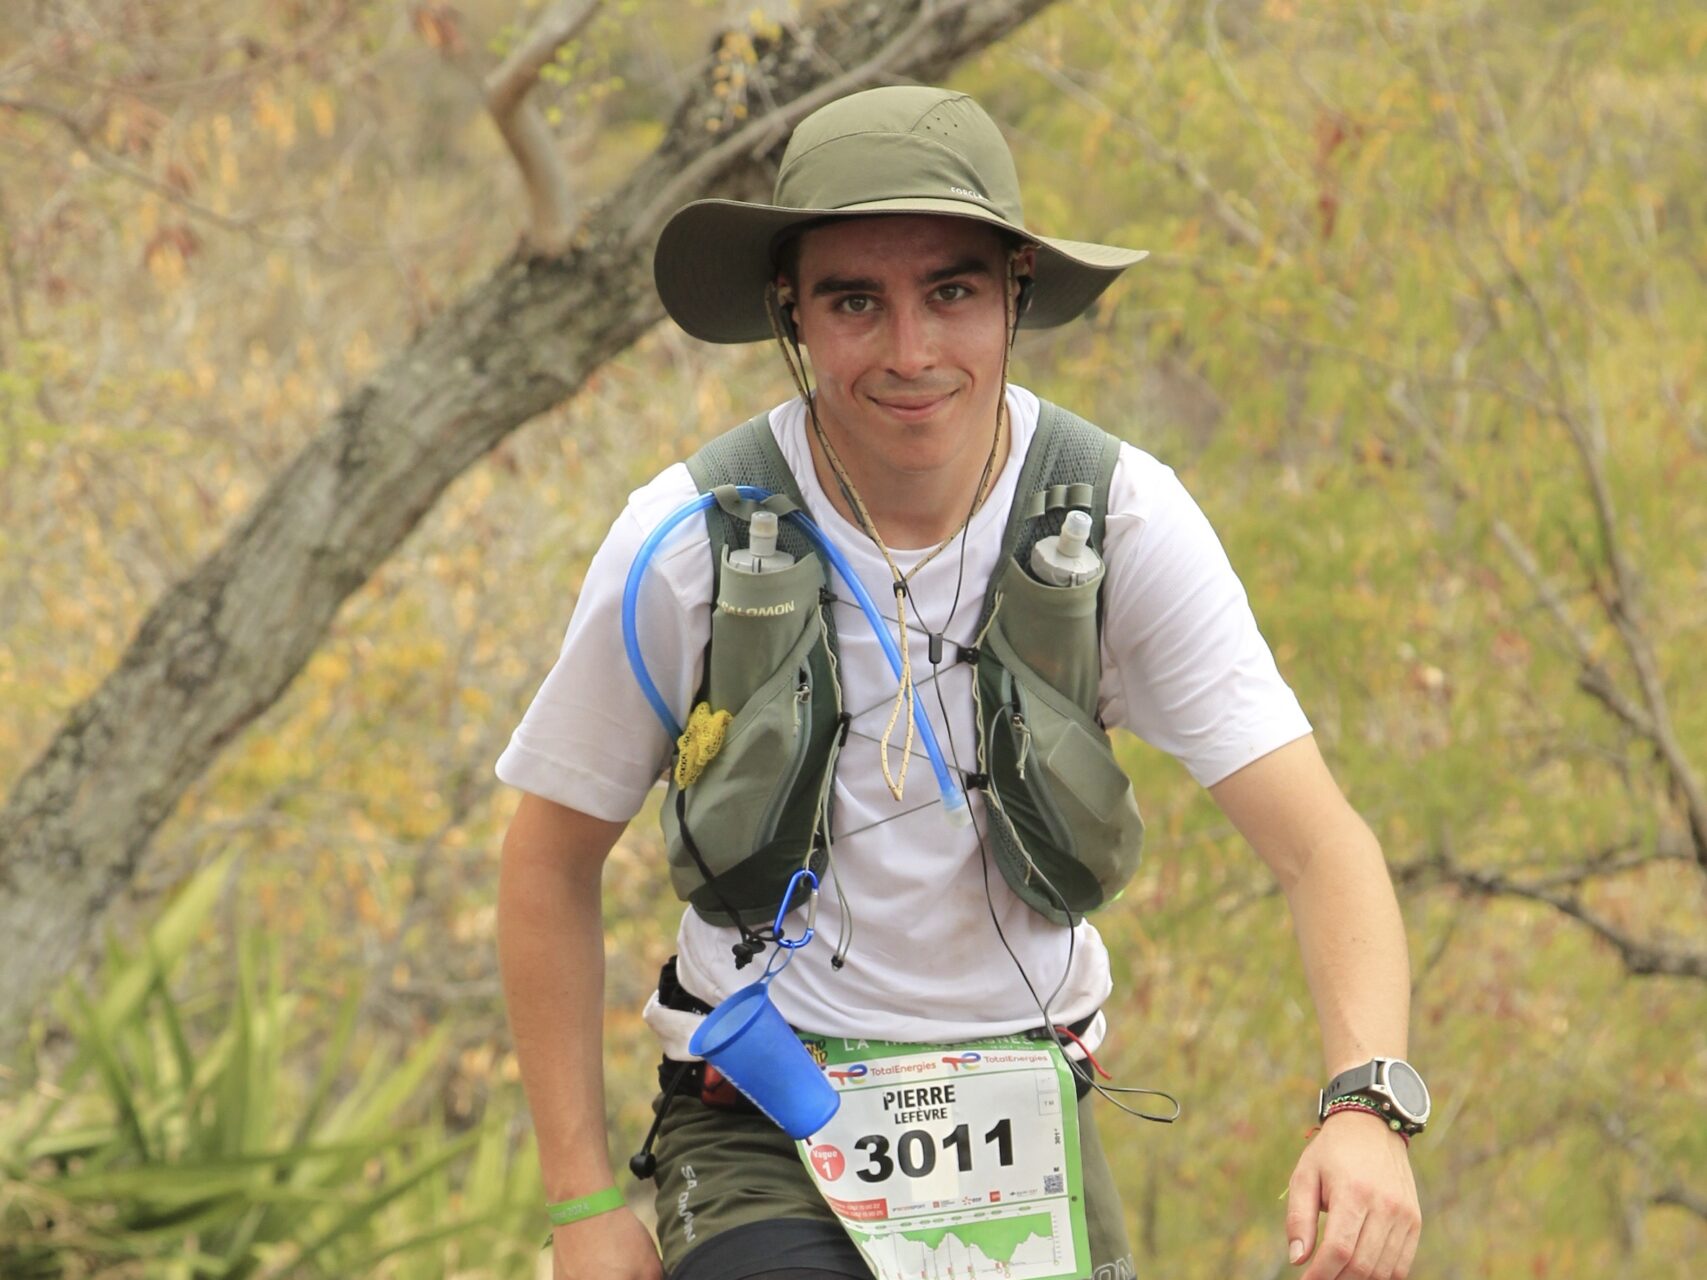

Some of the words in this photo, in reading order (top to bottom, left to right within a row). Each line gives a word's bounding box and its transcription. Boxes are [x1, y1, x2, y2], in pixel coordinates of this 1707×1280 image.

[950, 186, 989, 201] FORCL
[983, 1054, 1048, 1064] TotalEnergies
[870, 1061, 937, 1077] TotalEnergies
[883, 1084, 956, 1111] PIERRE
[894, 1107, 948, 1125] LEFÈVRE
[812, 1150, 838, 1160] Vague
[854, 1118, 1014, 1183] 3011
[822, 1161, 833, 1179] 1
[678, 1165, 697, 1242] SAOMN
